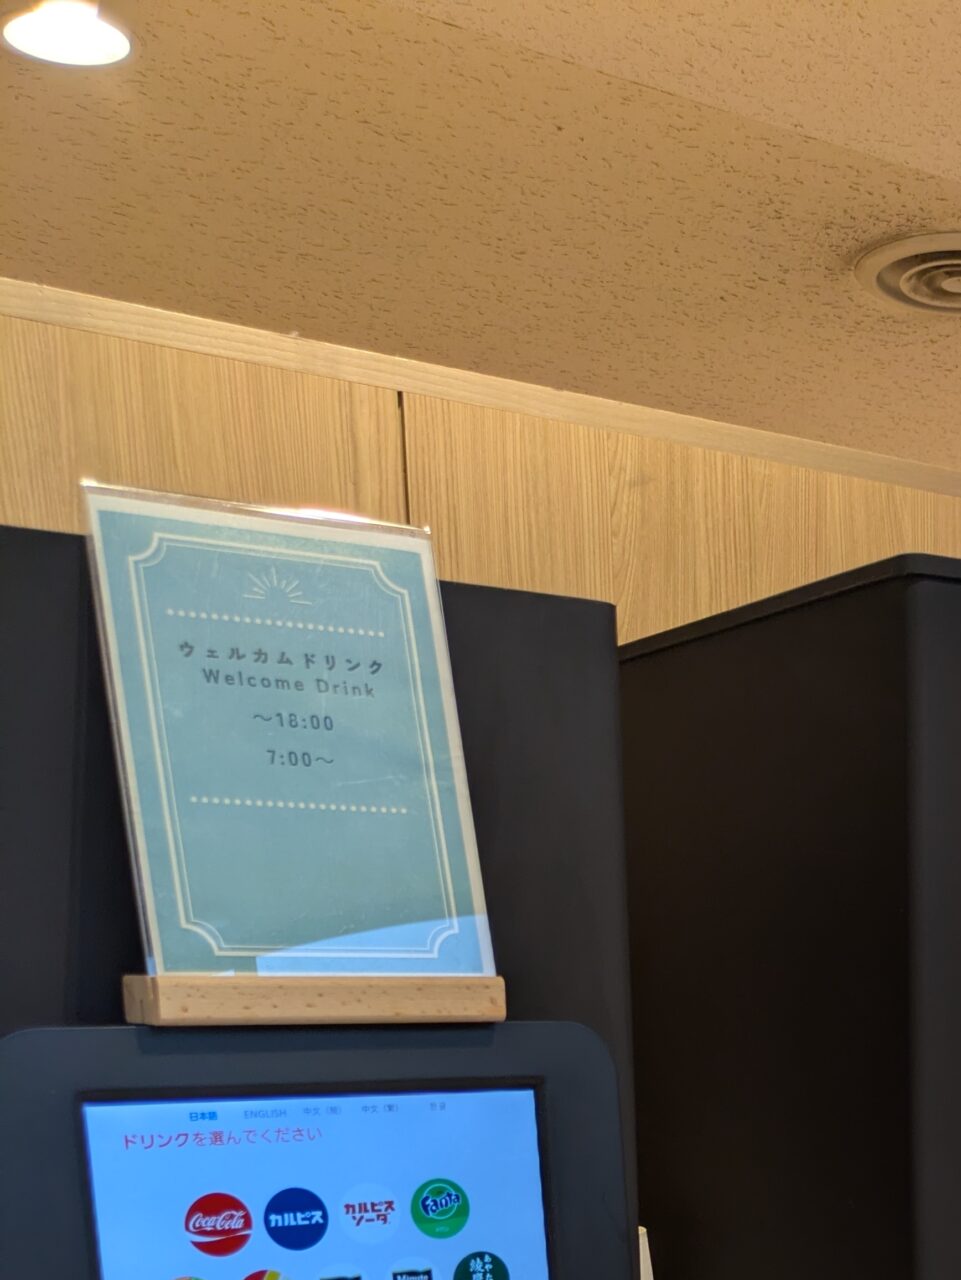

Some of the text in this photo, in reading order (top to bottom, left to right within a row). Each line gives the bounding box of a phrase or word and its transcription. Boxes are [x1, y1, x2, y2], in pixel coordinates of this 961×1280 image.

[179, 641, 383, 675] ウェルカムドリンク
[202, 668, 375, 698] Welcome Drink
[189, 1111, 218, 1122] 日本語
[244, 1109, 288, 1119] ENGLISH
[123, 1126, 323, 1150] ドリンクを選んでください
[344, 1200, 396, 1215] カルピス
[420, 1192, 462, 1217] Fanta
[269, 1209, 325, 1228] カルピス
[352, 1212, 391, 1227] ソーダ
